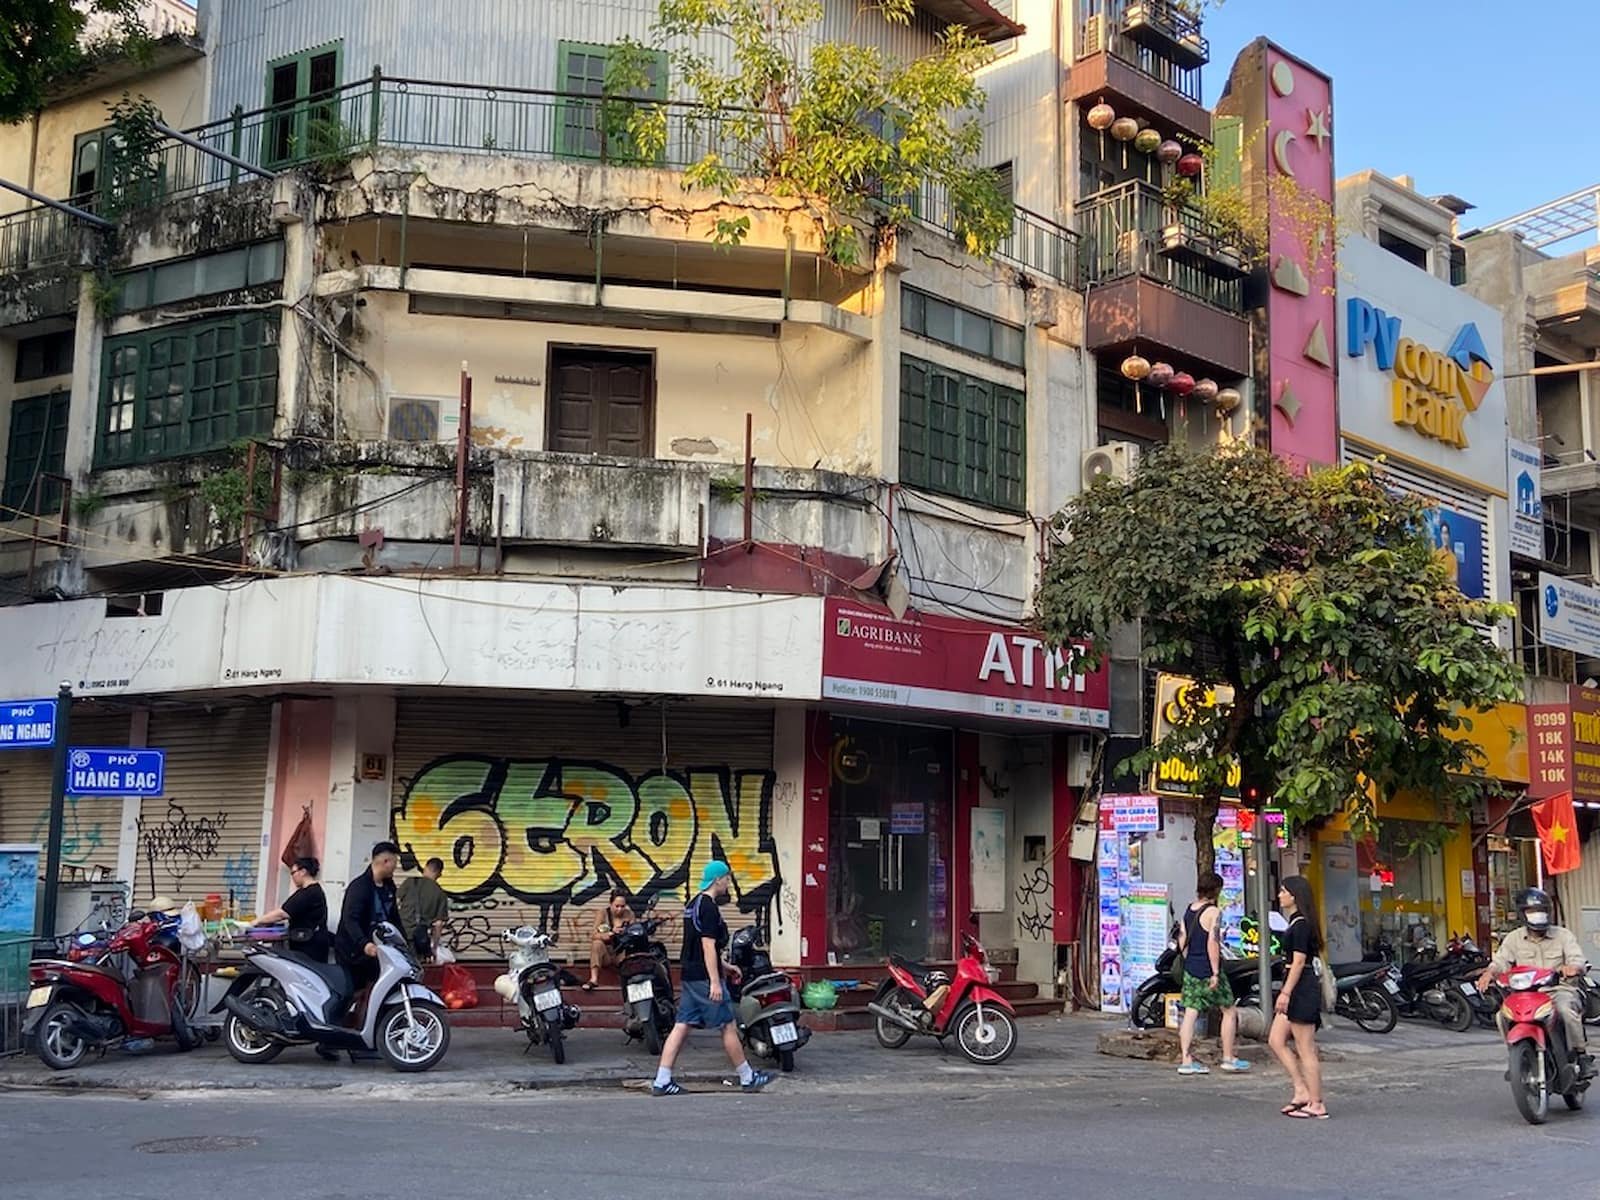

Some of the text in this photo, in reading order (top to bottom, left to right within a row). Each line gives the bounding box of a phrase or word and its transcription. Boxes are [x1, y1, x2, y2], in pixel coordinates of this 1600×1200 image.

[1392, 379, 1469, 449] Bank
[851, 625, 922, 647] AGRIBANK
[979, 632, 1085, 691] ATM
[717, 679, 728, 687] 61
[755, 681, 783, 691] Ngang
[11, 704, 35, 717] PHỐ
[1533, 711, 1566, 727] 9999
[17, 722, 51, 740] NGANG
[1537, 731, 1563, 745] 18K
[108, 753, 137, 765] PHỐ
[1540, 749, 1565, 763] 14K
[75, 768, 157, 791] HÀNG BẠC
[1540, 768, 1566, 782] 10K
